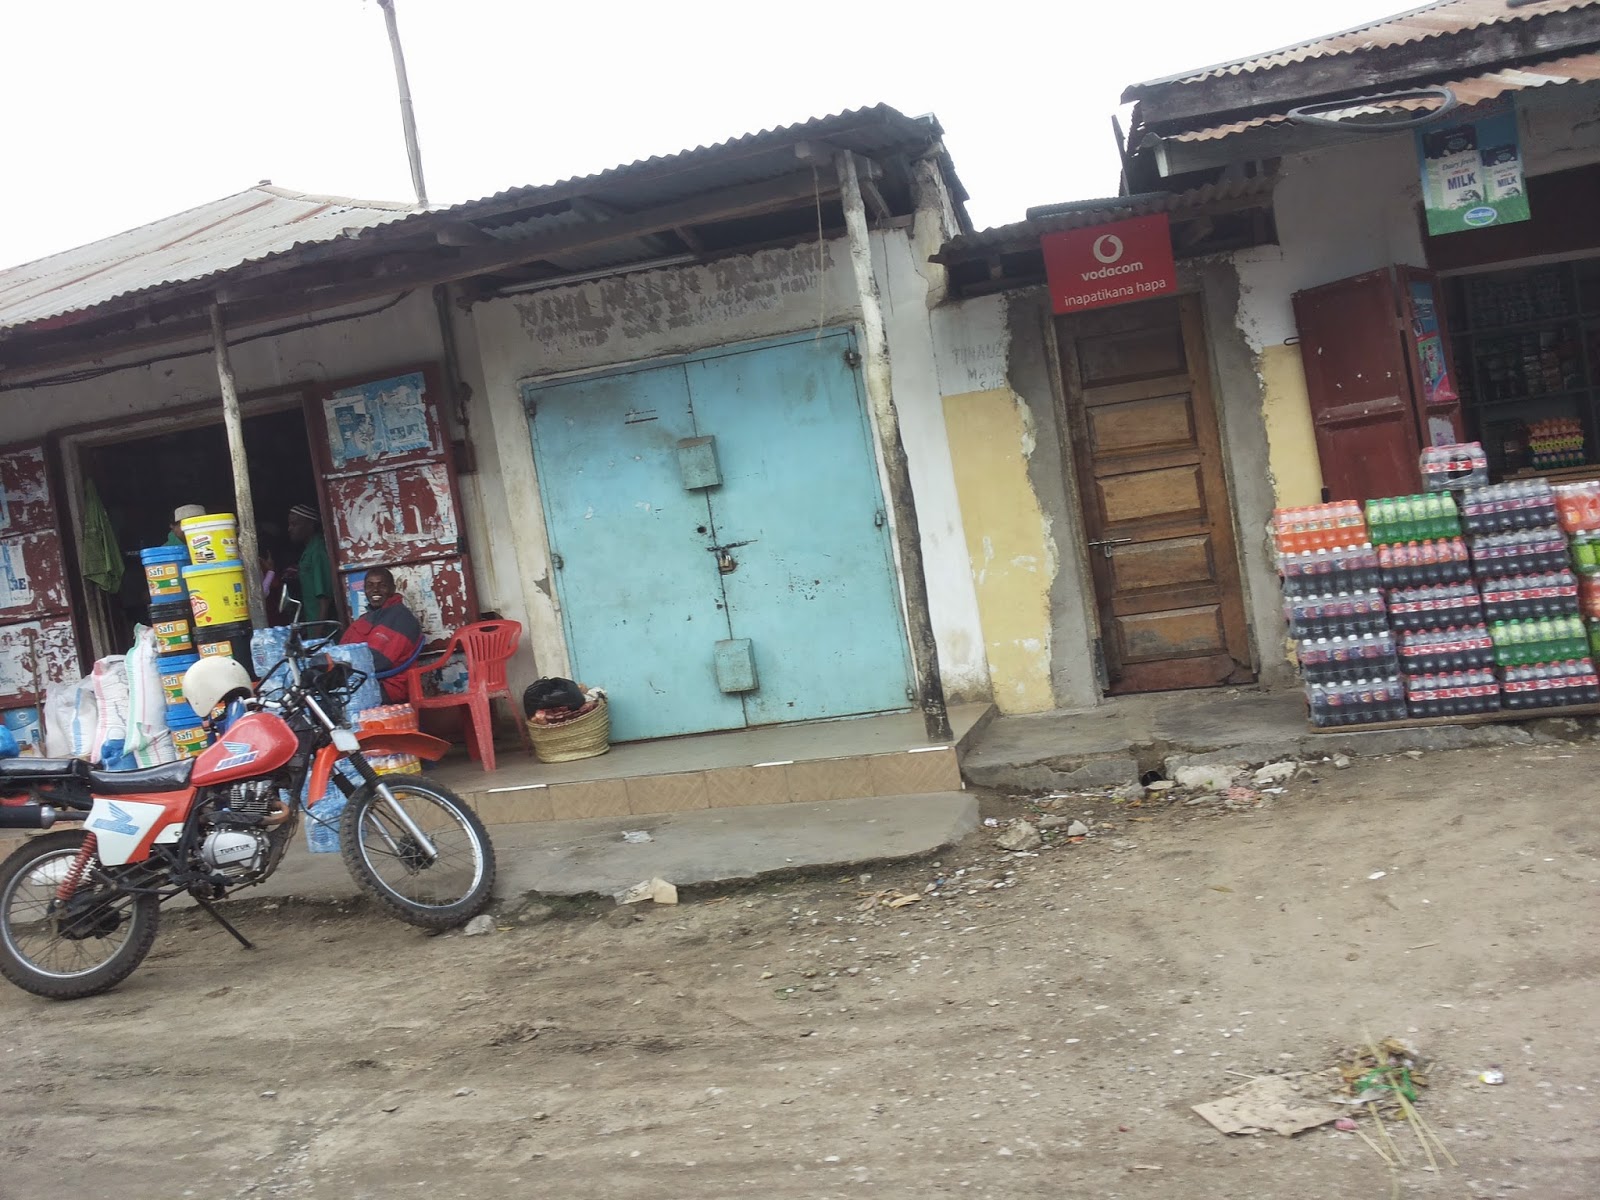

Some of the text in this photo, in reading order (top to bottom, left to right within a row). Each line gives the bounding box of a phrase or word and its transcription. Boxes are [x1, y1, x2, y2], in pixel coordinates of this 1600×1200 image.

[1447, 172, 1477, 190] MILK
[1497, 175, 1518, 188] MILK
[1081, 261, 1144, 281] vodacom
[1064, 279, 1167, 306] inapatikana hapa
[149, 567, 164, 576] Safi
[158, 624, 174, 633] Safi
[202, 645, 217, 654] Safi
[163, 677, 177, 686] Safi
[176, 731, 192, 740] Safi
